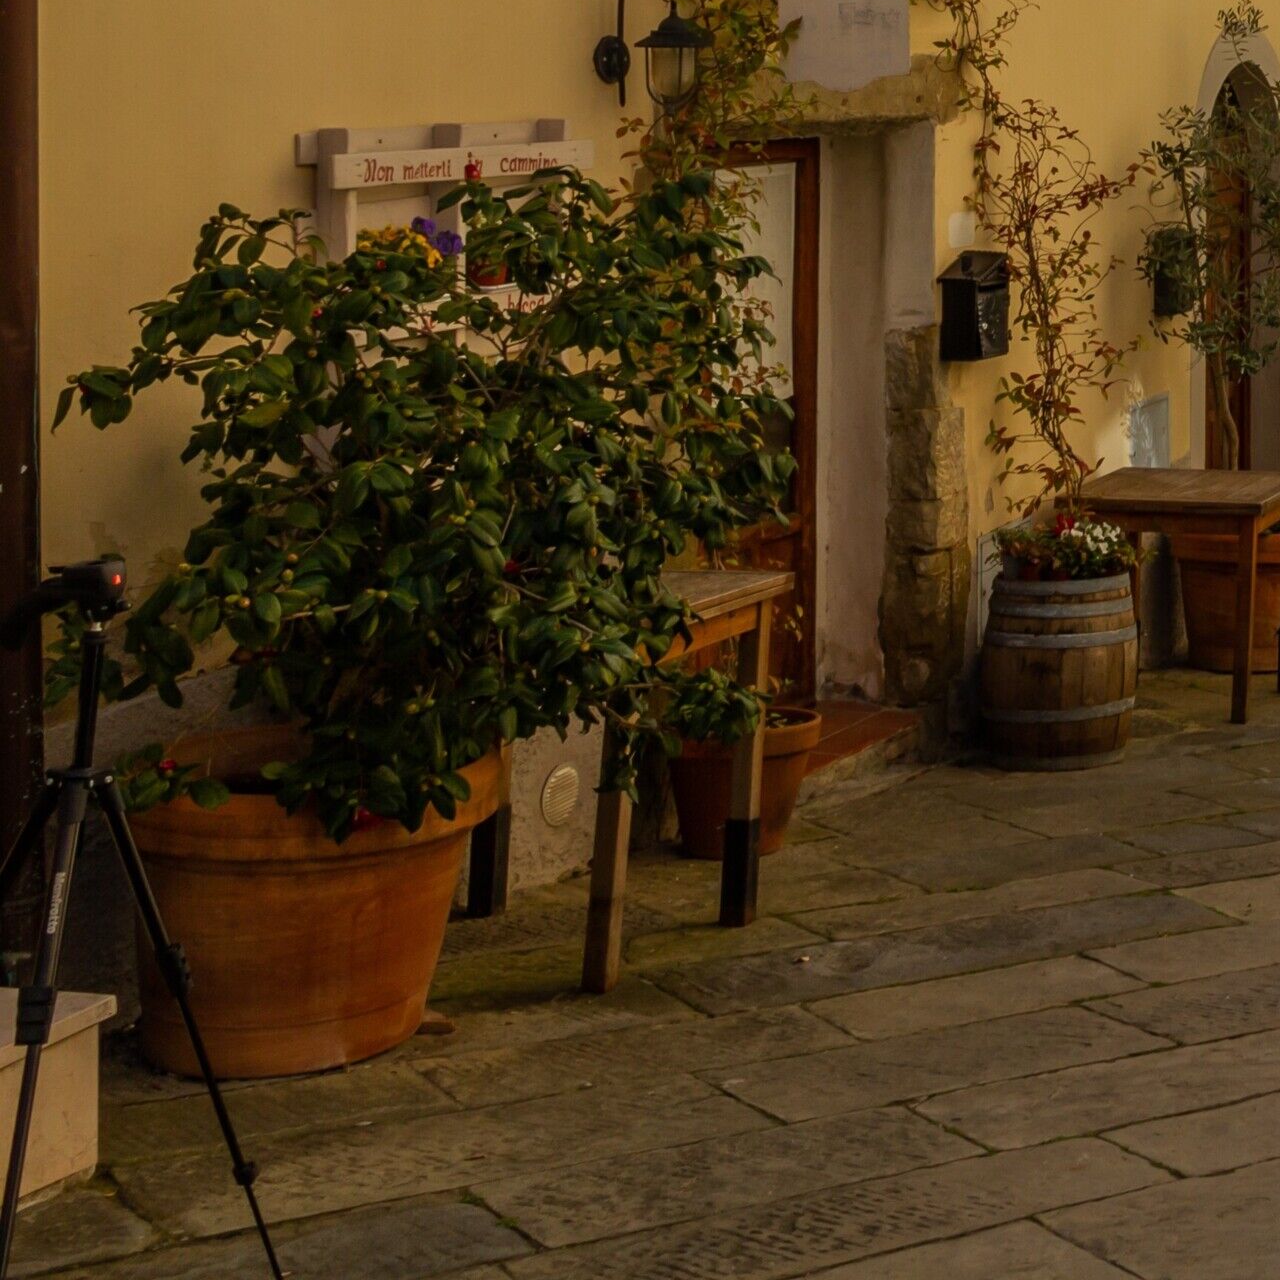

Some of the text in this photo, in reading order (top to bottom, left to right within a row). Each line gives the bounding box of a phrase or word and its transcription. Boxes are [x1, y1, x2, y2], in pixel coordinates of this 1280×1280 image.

[363, 158, 395, 183] Non
[507, 294, 545, 313] bcca
[46, 872, 66, 934] Manfrotto
